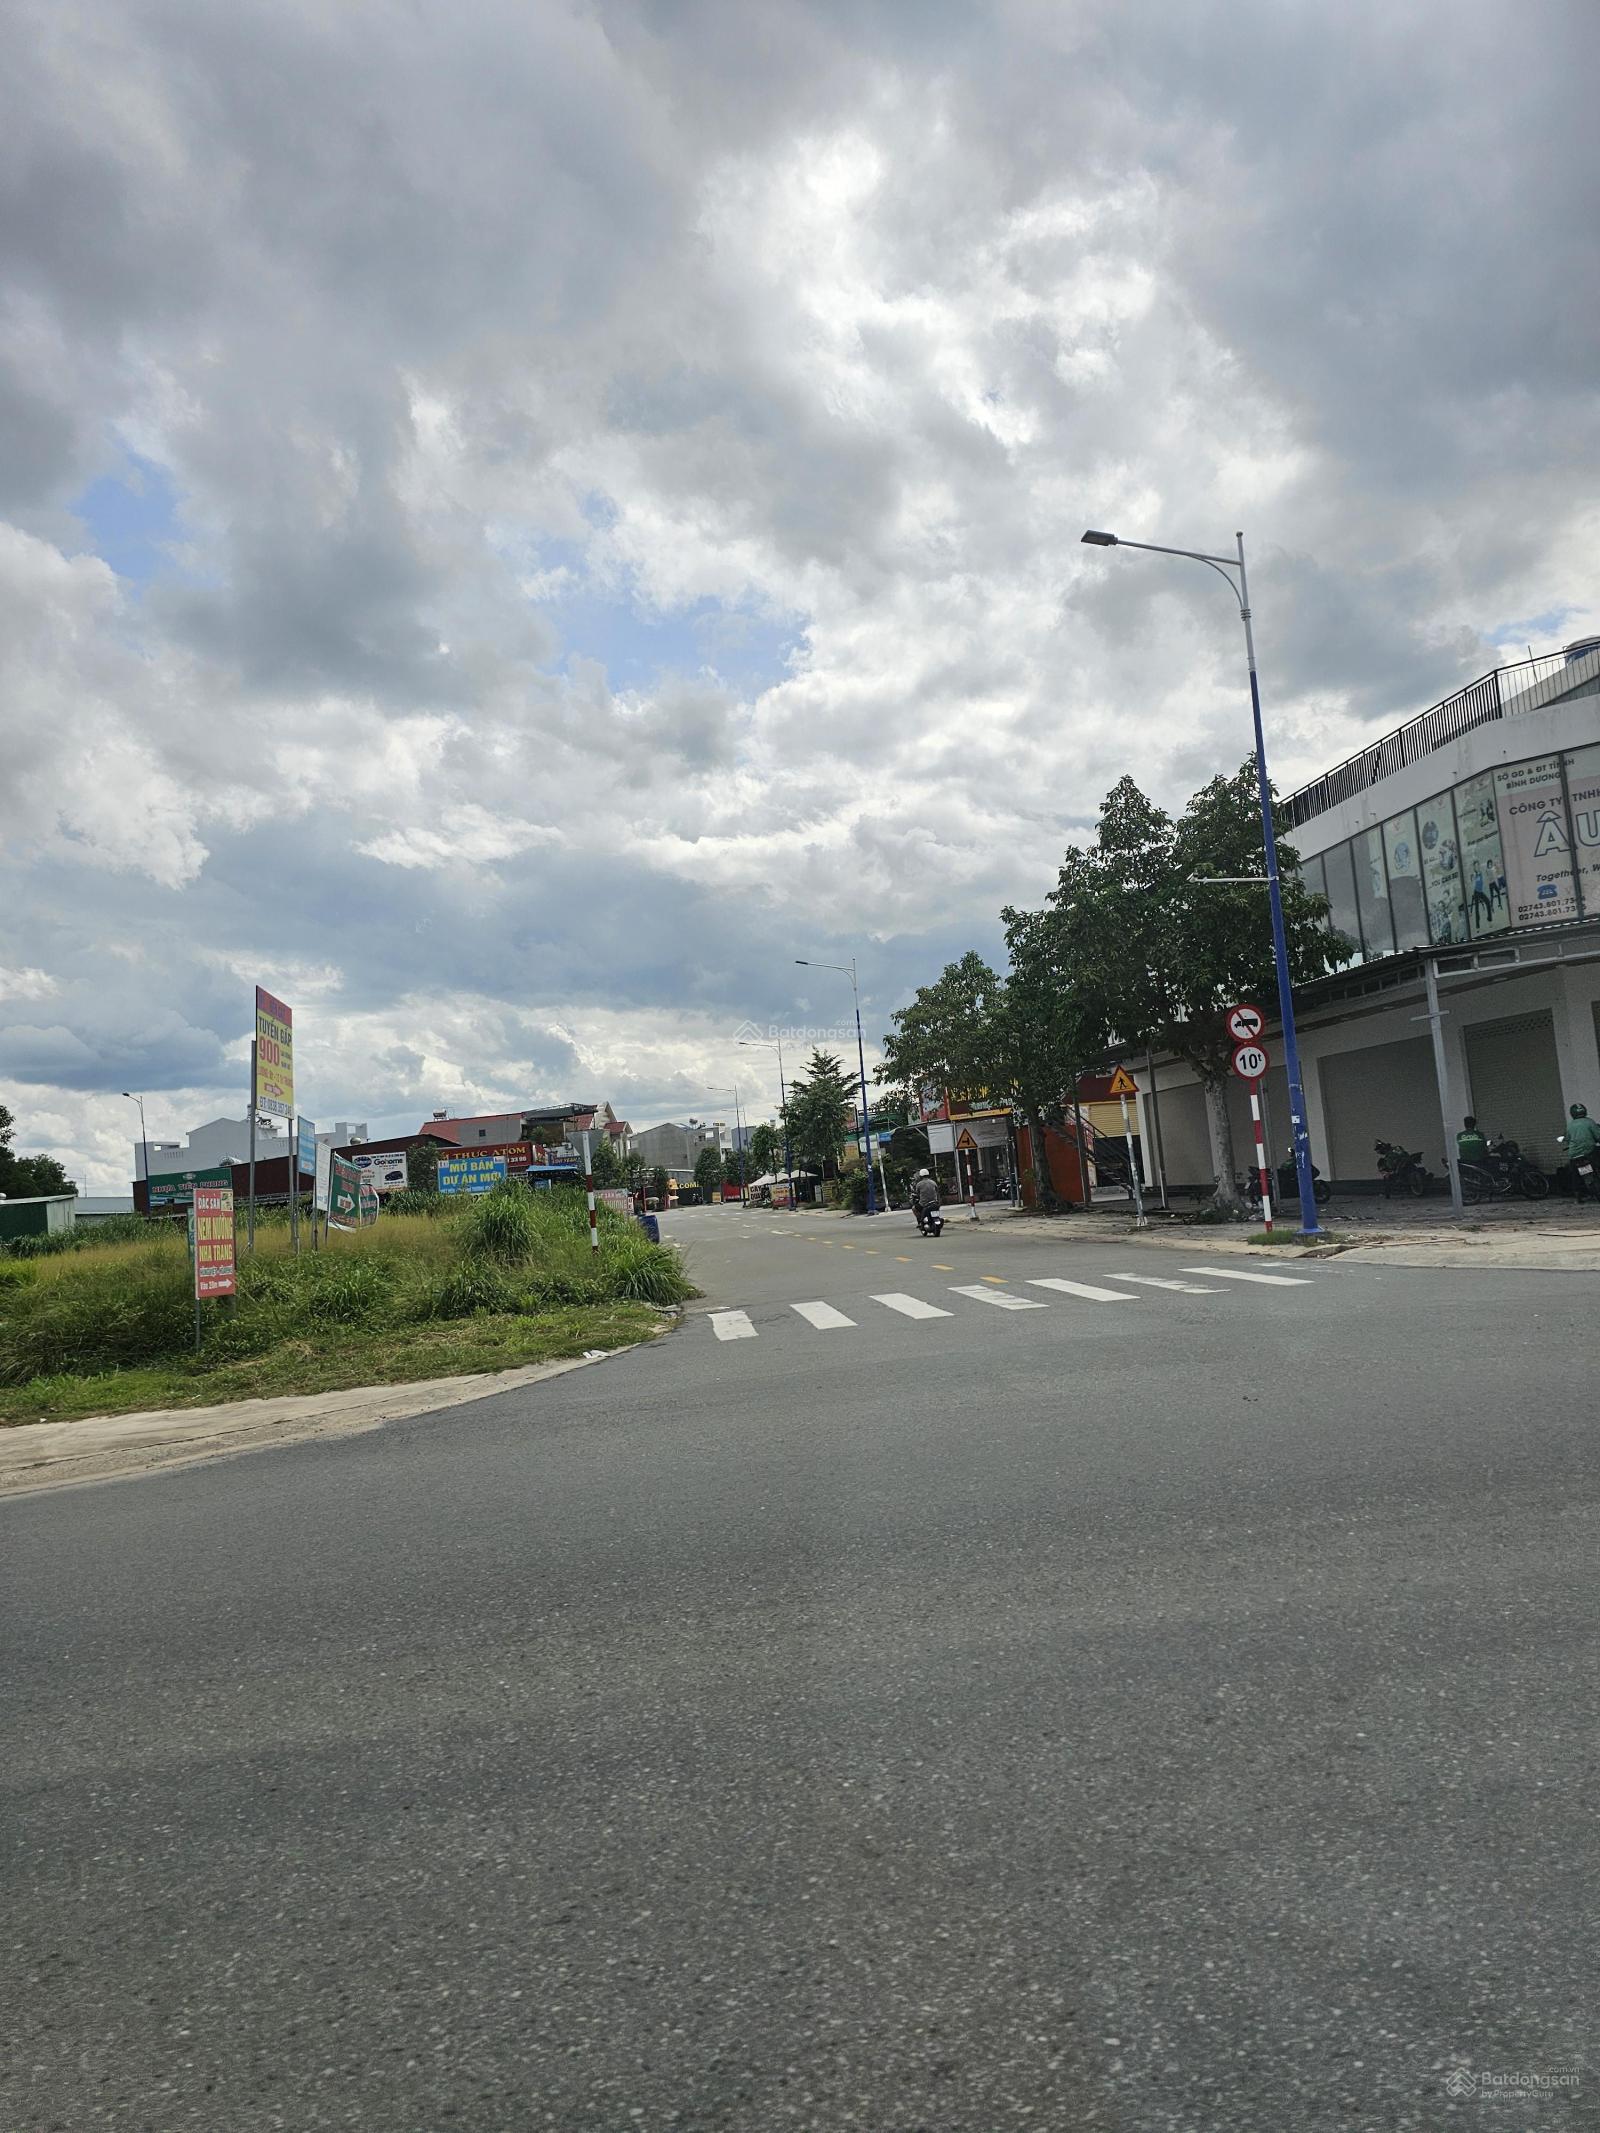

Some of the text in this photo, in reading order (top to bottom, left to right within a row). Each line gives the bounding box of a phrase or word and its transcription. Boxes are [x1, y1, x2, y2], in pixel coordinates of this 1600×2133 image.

[1497, 772, 1508, 781] SỞ
[1511, 769, 1524, 778] GD
[1535, 764, 1546, 773] ĐT
[1506, 771, 1561, 789] BÌNH DƯƠNG
[1508, 800, 1545, 815] CÔNG
[1549, 796, 1562, 807] TY
[259, 1035, 280, 1067] 900
[1239, 1053, 1262, 1070] 10t
[492, 1146, 526, 1157] ATOM
[449, 1159, 468, 1173] MỞ
[470, 1159, 494, 1171] BÁN
[443, 1172, 460, 1187] DỰ
[461, 1172, 477, 1184] ÁN
[198, 1194, 209, 1213] ĐẶC
[199, 1243, 233, 1262] NHA TRANG
